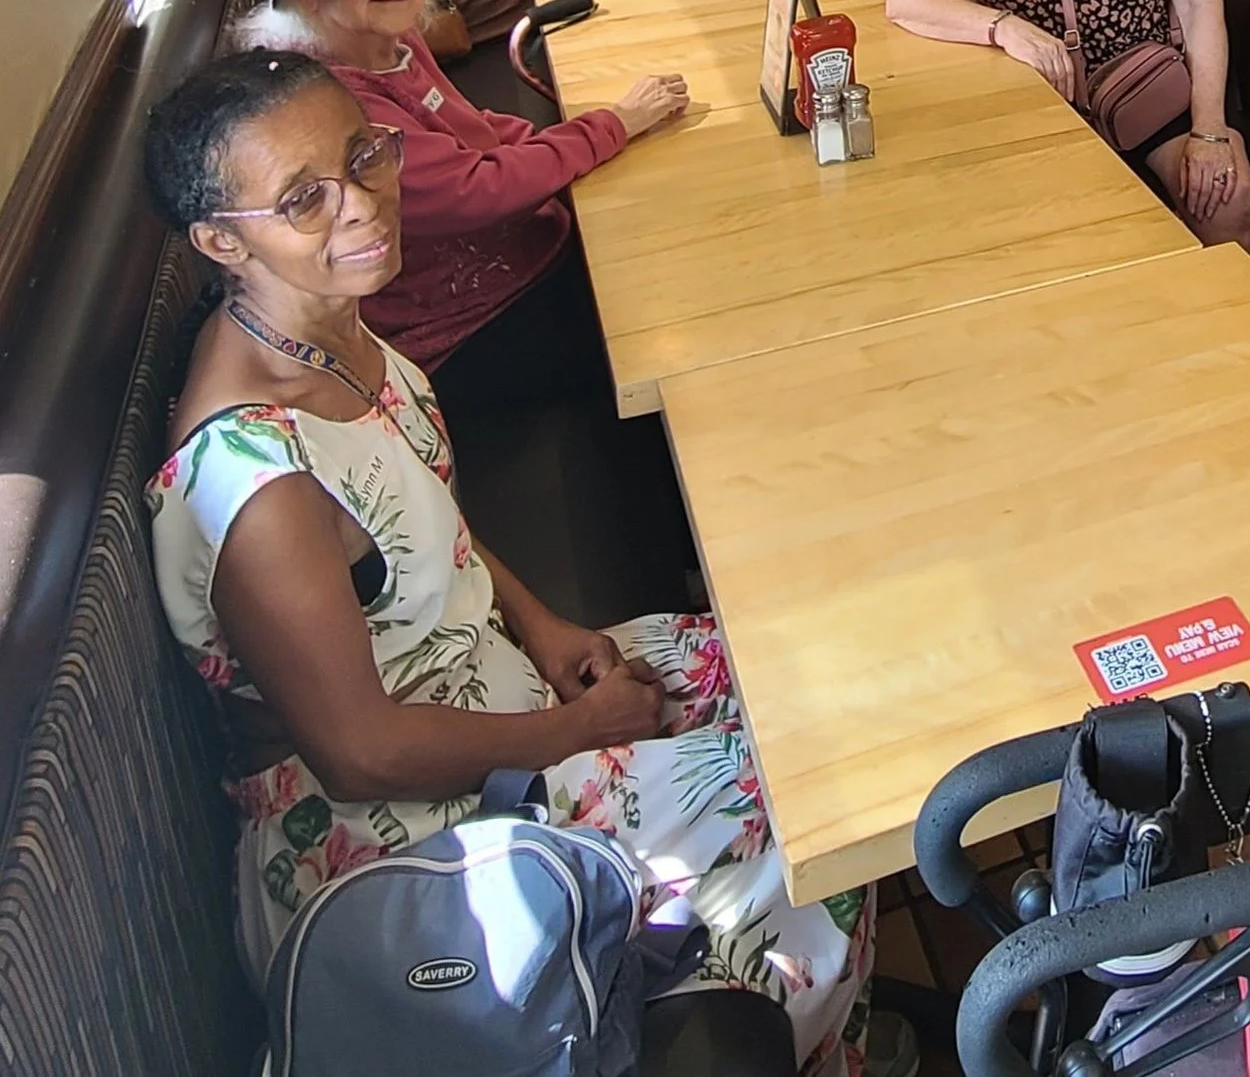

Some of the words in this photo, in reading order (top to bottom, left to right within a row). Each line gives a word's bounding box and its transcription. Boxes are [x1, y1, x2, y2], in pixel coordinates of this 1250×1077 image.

[820, 54, 841, 64] HEINZ
[1178, 622, 1204, 640] PAY
[1207, 623, 1245, 645] VIEW
[1164, 635, 1206, 659] MENU
[1180, 653, 1195, 663] TO
[415, 965, 470, 982] SAVERRY
